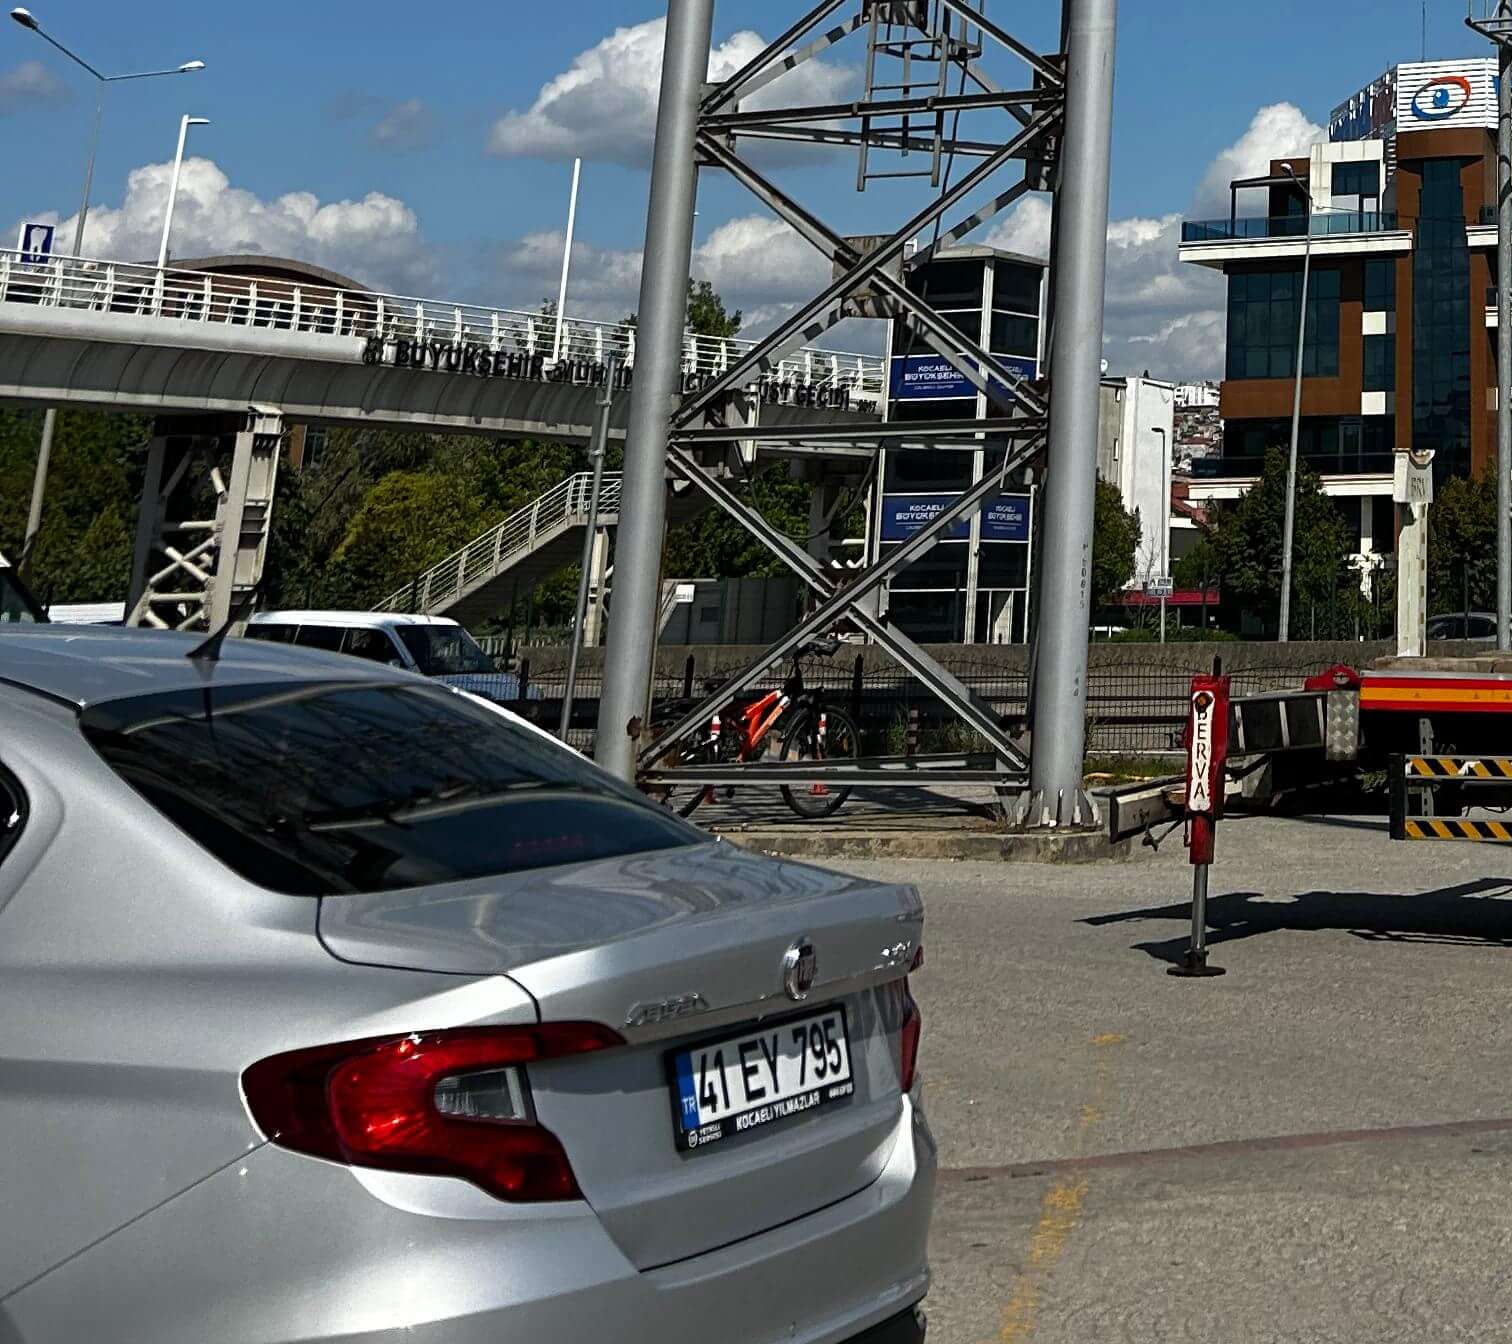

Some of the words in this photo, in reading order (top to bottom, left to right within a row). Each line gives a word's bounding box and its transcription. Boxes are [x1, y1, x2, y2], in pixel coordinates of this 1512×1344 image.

[698, 1050, 730, 1114] 41
[738, 1034, 781, 1103] EY
[793, 1016, 843, 1087] 795
[682, 1096, 697, 1115] TR
